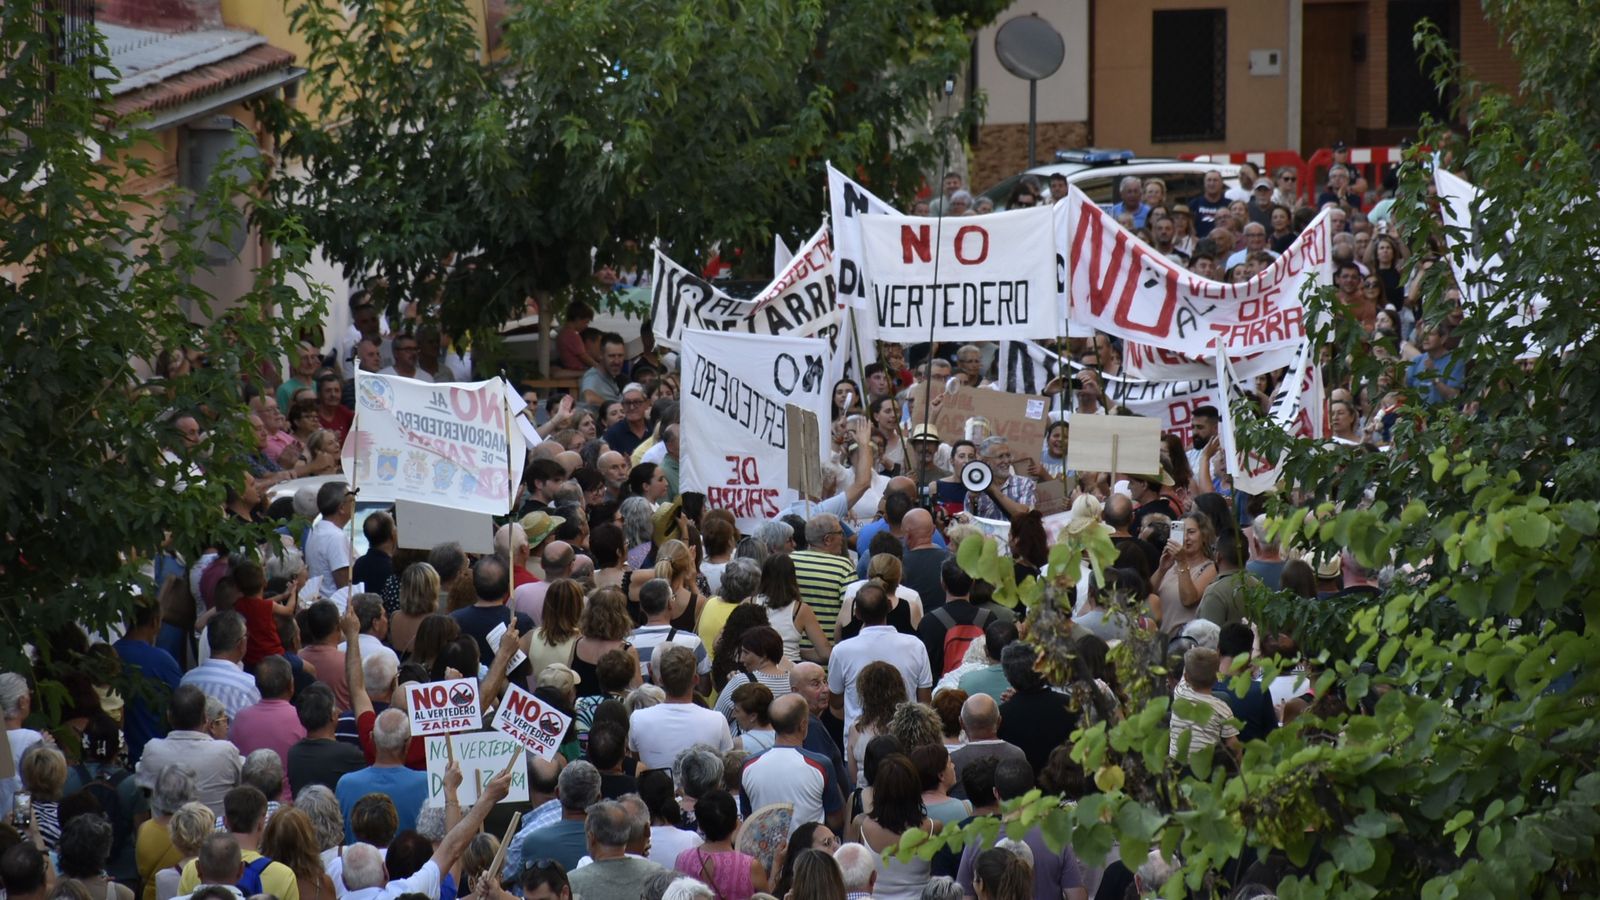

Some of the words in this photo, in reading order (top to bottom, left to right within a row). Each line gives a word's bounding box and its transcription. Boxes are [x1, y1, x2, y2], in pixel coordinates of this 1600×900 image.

[901, 225, 989, 265] NO
[1070, 202, 1179, 338] NO
[875, 280, 1028, 328] VERTEDERO
[1239, 288, 1280, 322] DE
[1206, 306, 1306, 348] ZARRA
[411, 685, 448, 711] NO
[414, 711, 427, 721] AL
[428, 705, 476, 719] VERTEDERO
[506, 690, 541, 722] NO
[421, 718, 471, 731] ZARRA
[501, 709, 512, 721] AL
[512, 717, 556, 747] VERTEDERO
[501, 722, 544, 754] ZARRA
[432, 772, 444, 798] D
